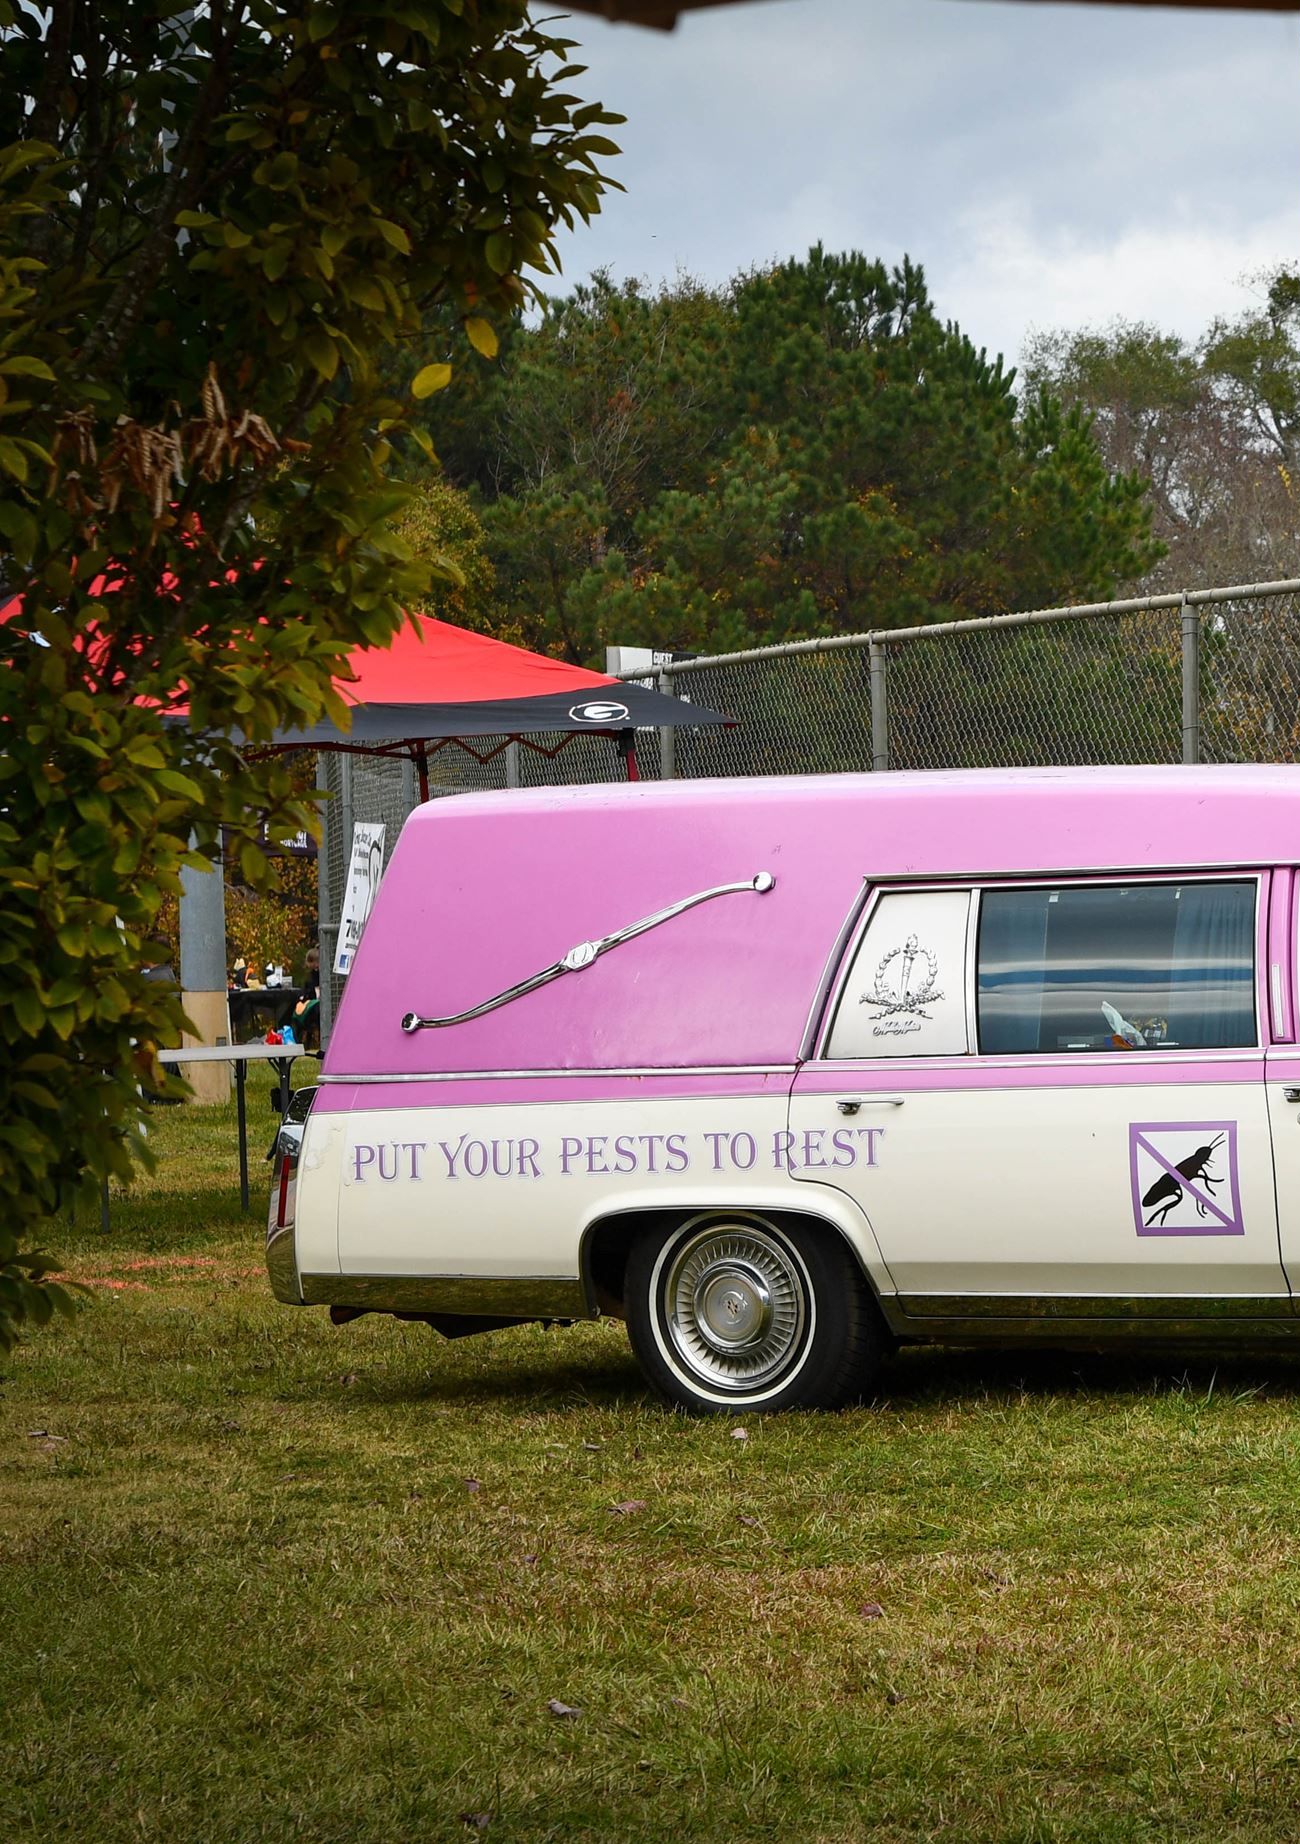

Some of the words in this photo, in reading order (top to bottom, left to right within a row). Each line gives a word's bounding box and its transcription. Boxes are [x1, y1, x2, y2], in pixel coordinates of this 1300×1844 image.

[654, 652, 673, 665] GUEST
[353, 1142, 427, 1180] PUT
[439, 1133, 543, 1179] YOUR
[559, 1134, 691, 1175] PESTS
[702, 1132, 758, 1171] TO
[772, 1127, 886, 1171] REST
